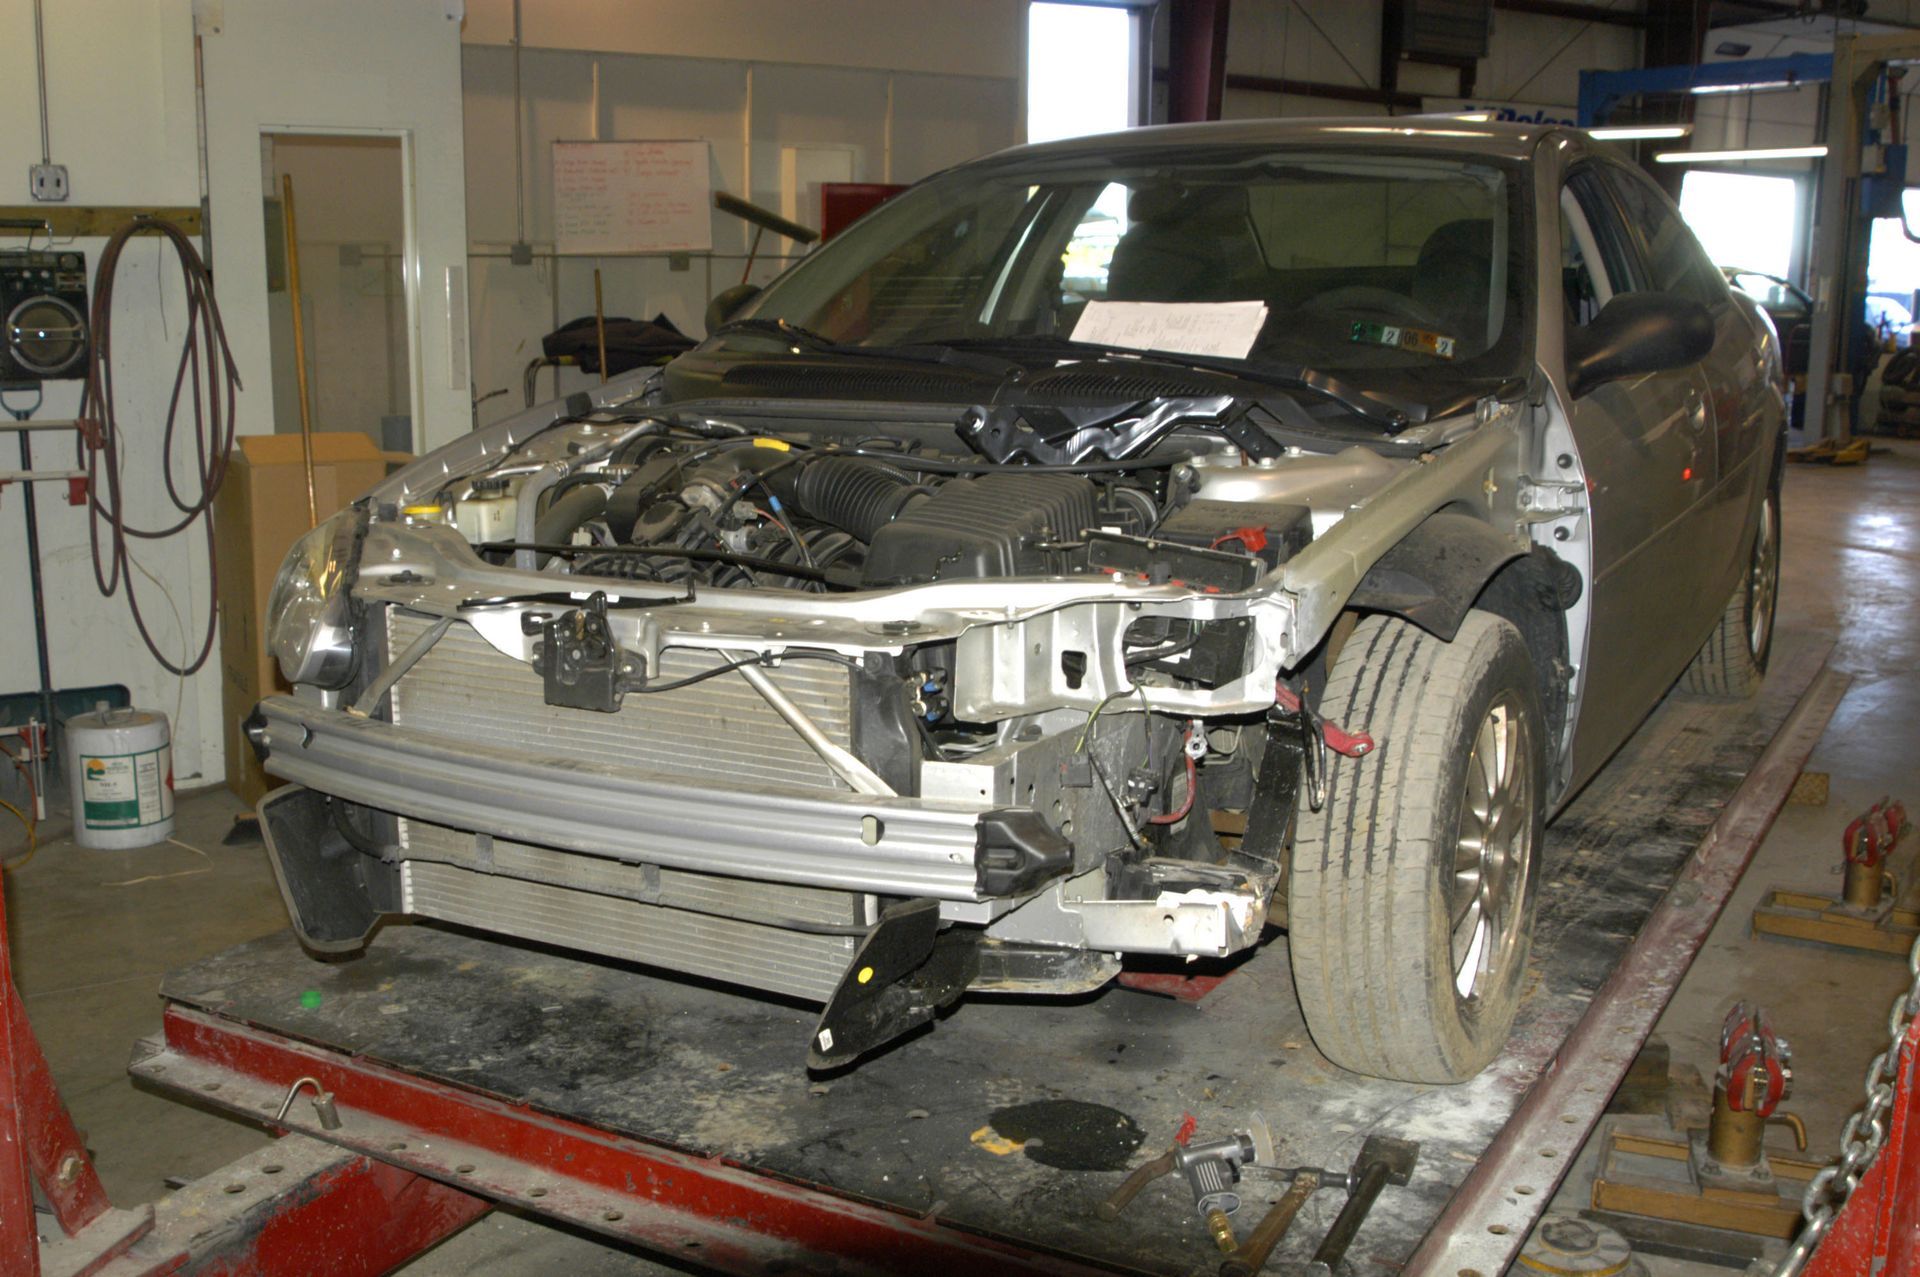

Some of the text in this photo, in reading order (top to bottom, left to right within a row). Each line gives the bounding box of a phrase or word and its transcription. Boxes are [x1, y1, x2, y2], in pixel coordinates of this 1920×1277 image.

[1385, 330, 1395, 344] 2
[1404, 331, 1449, 353] 06 2
